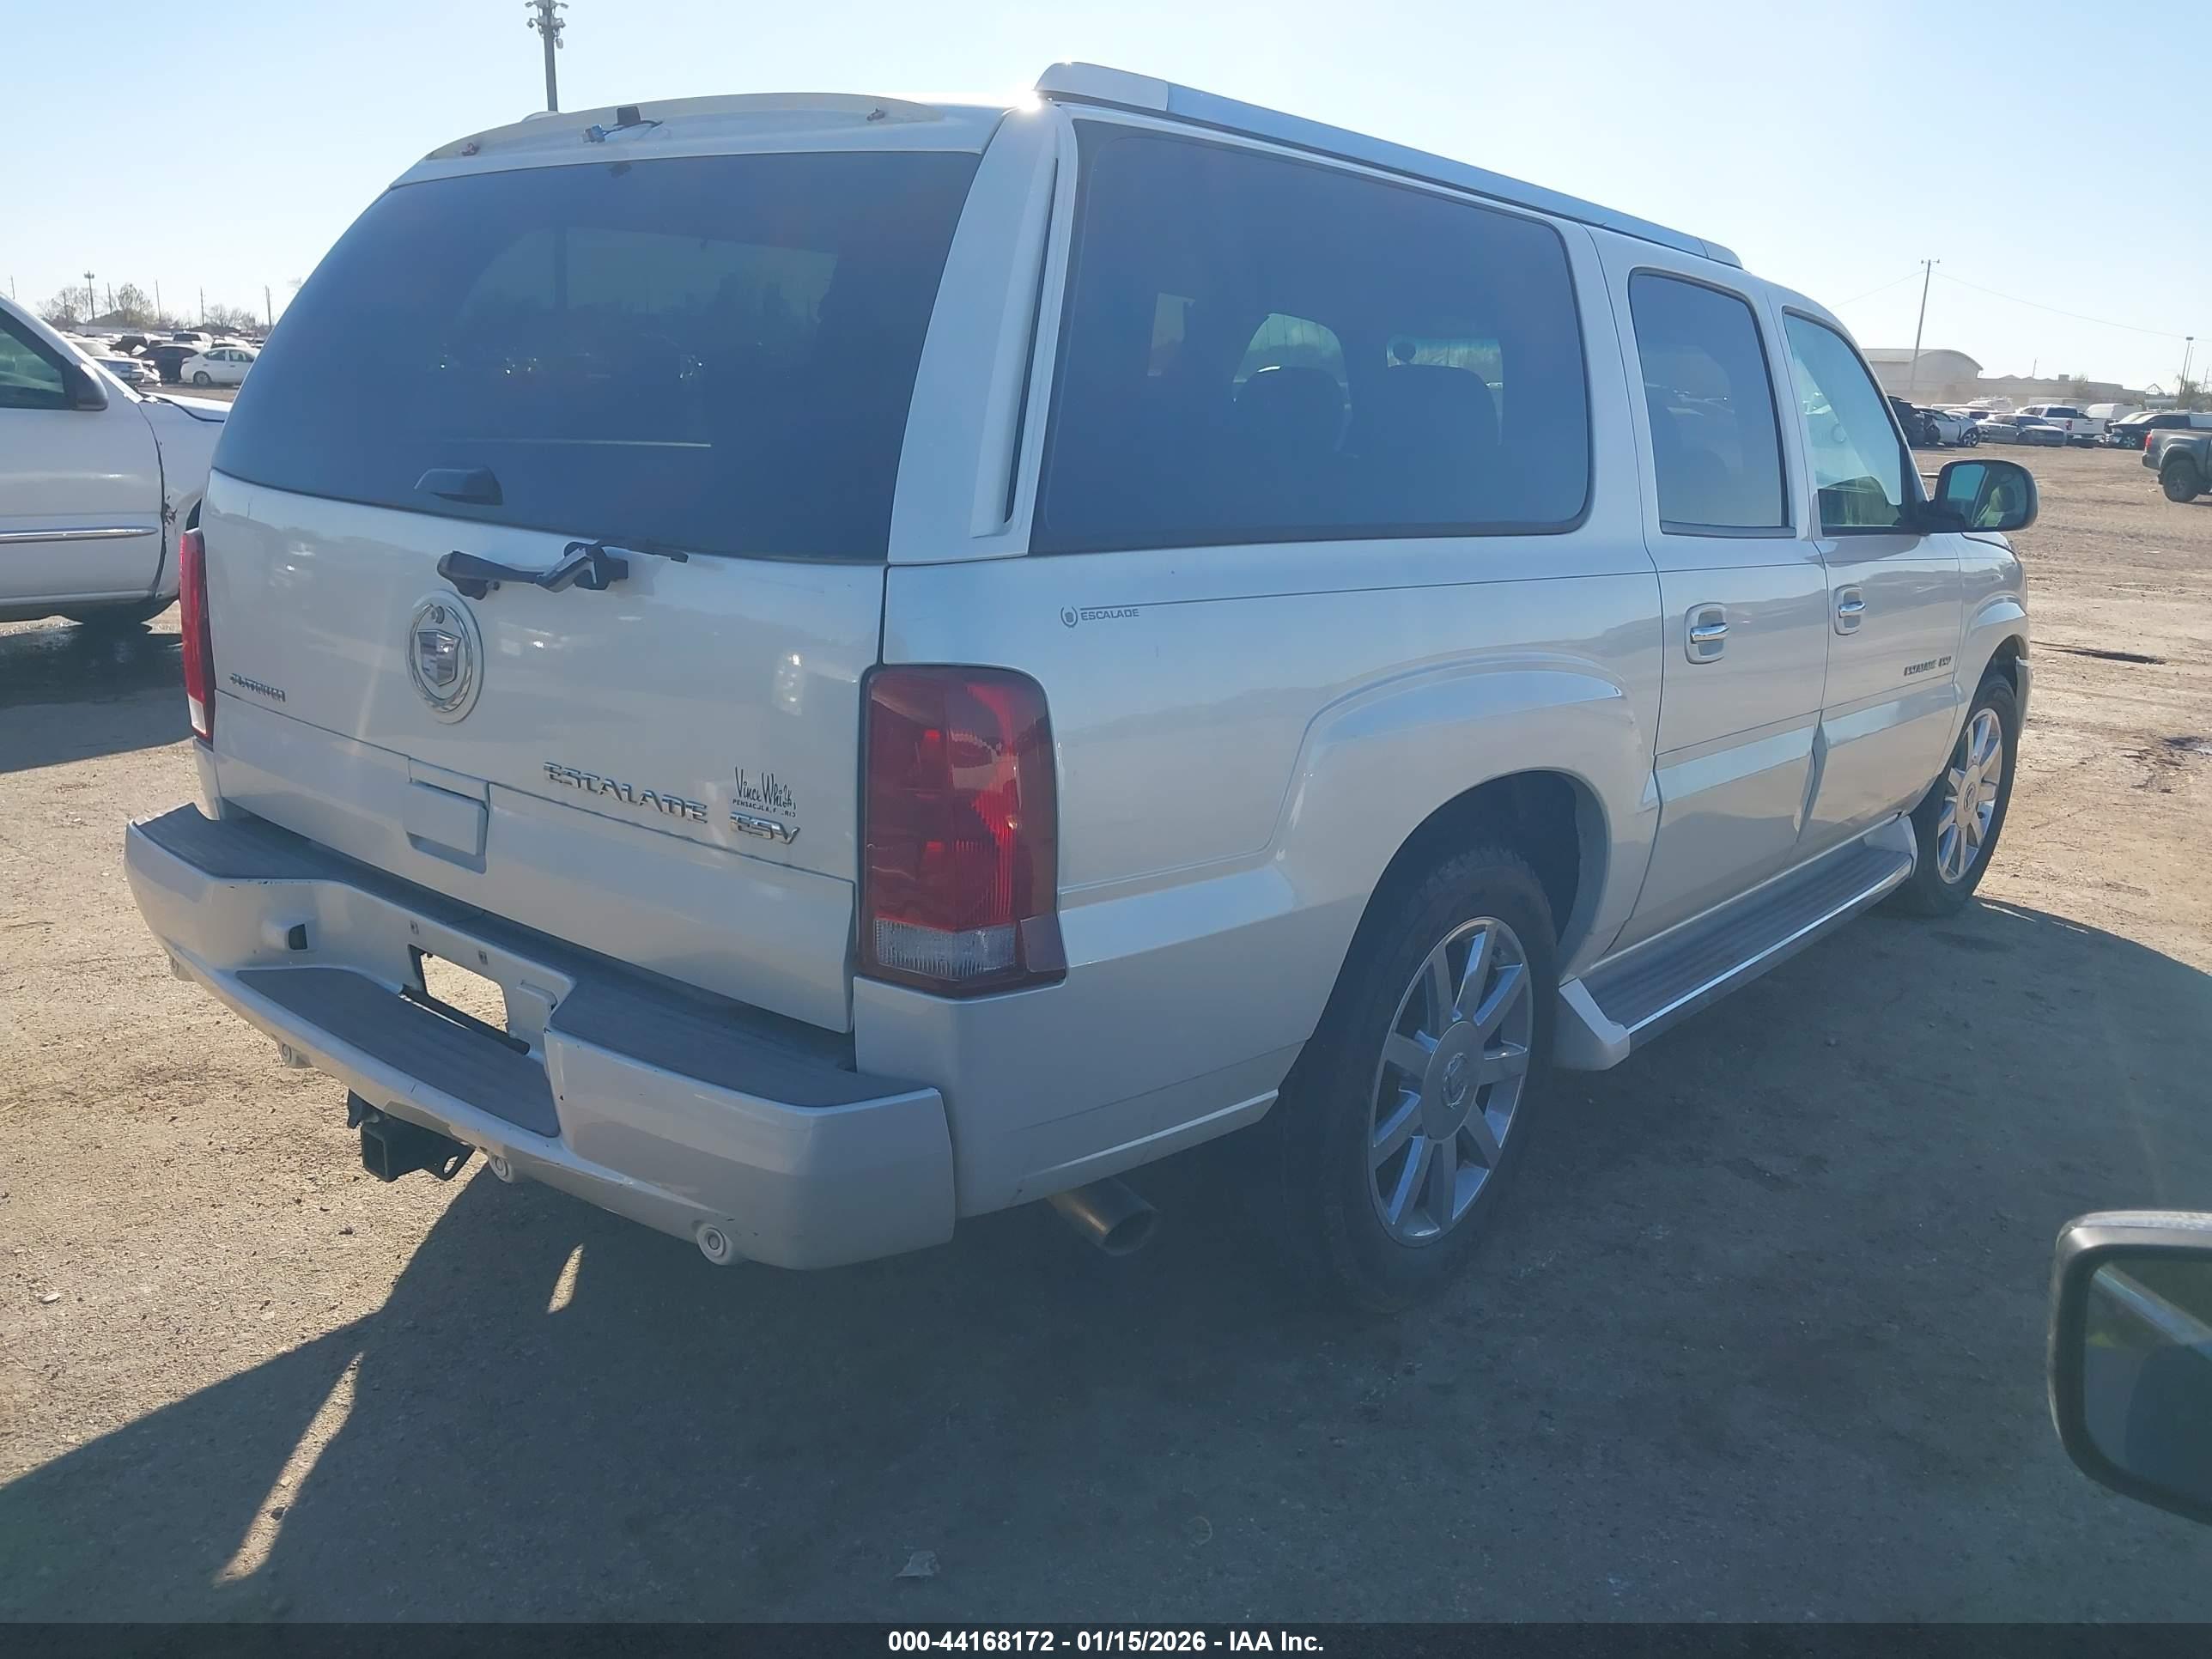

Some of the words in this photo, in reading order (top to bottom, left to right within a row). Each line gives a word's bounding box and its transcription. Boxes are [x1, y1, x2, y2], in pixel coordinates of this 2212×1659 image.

[1080, 608, 1139, 621] ESCALADE
[735, 766, 762, 802] Vince
[543, 762, 708, 824] ESCALADE
[729, 811, 800, 845] ESV
